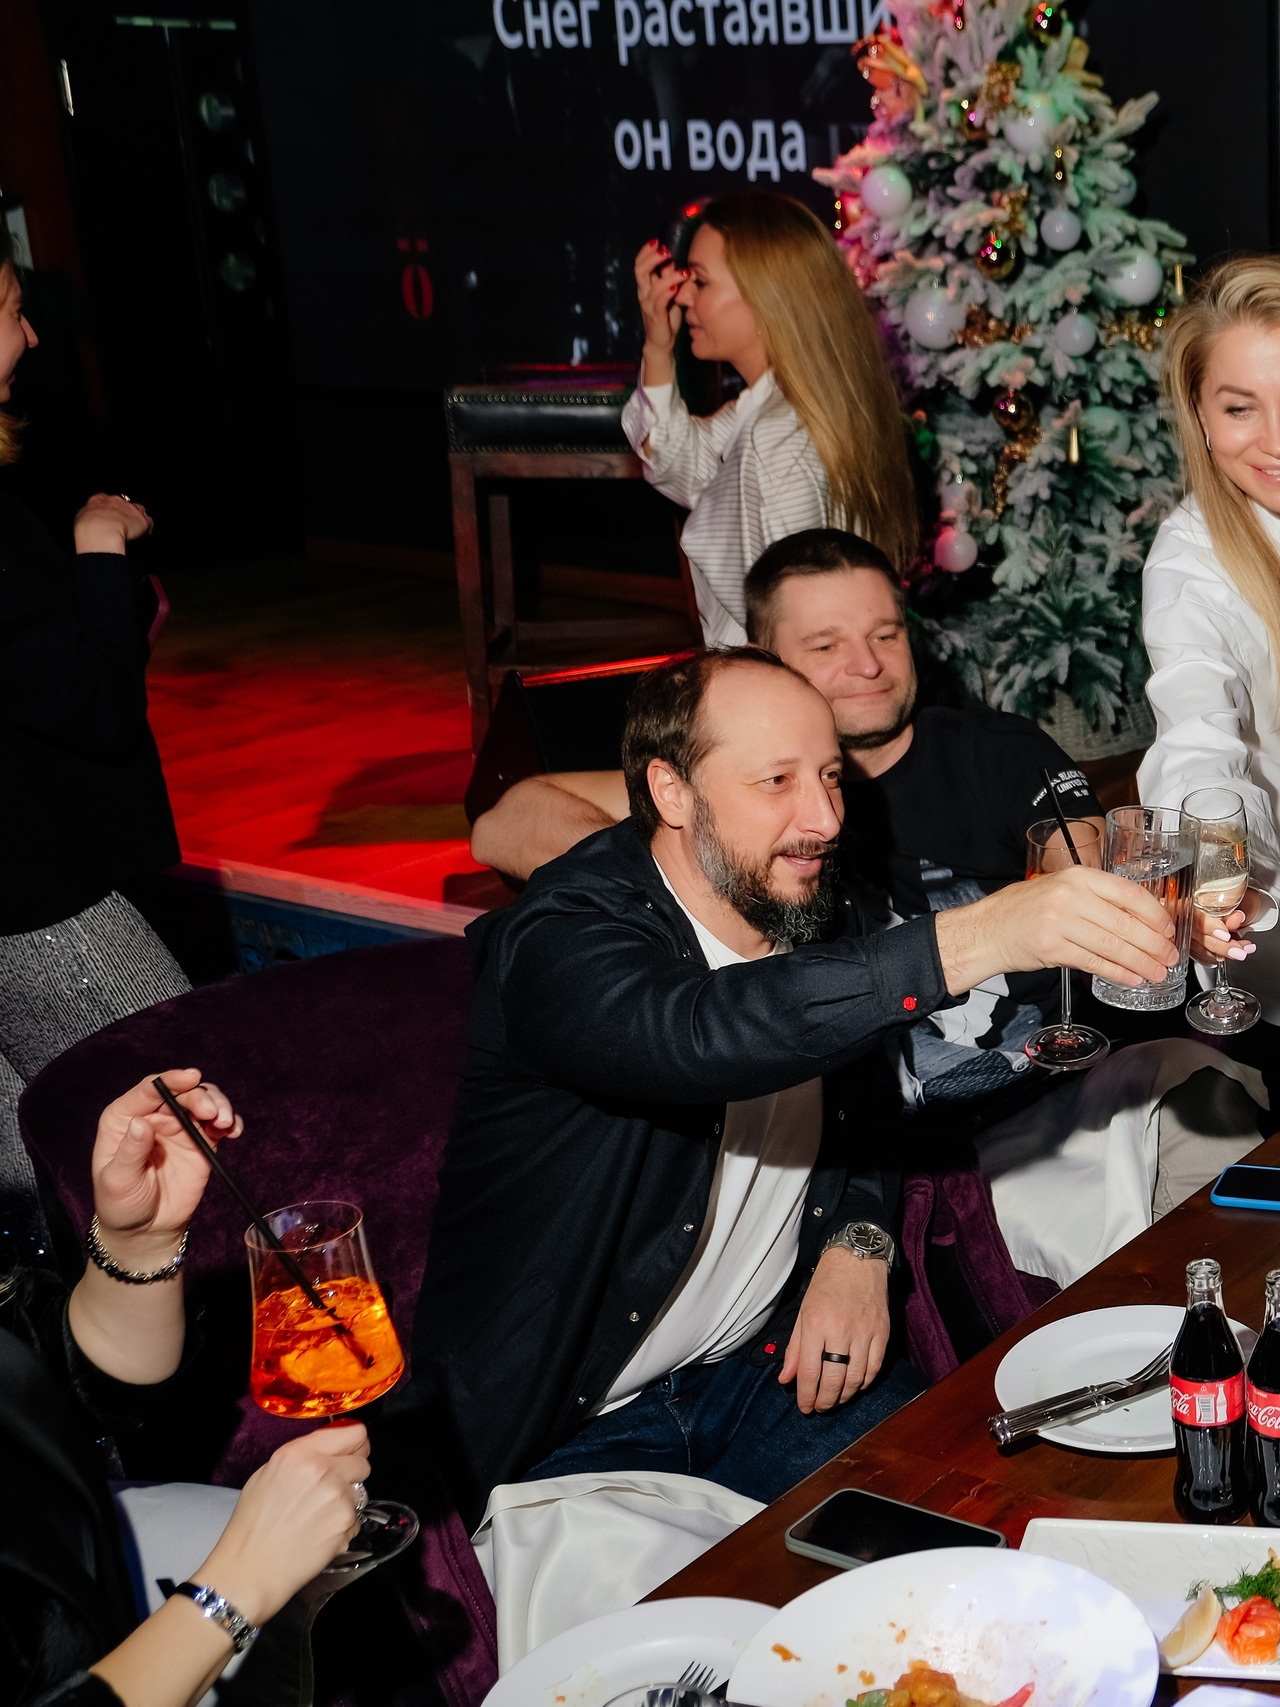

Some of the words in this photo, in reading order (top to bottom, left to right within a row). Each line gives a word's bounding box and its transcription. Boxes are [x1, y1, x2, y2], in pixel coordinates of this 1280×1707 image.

[494, 0, 599, 48] Снег
[615, 121, 671, 170] он
[687, 121, 806, 181] вода
[1057, 779, 1083, 794] LIMITED
[1058, 770, 1080, 781] BLACK
